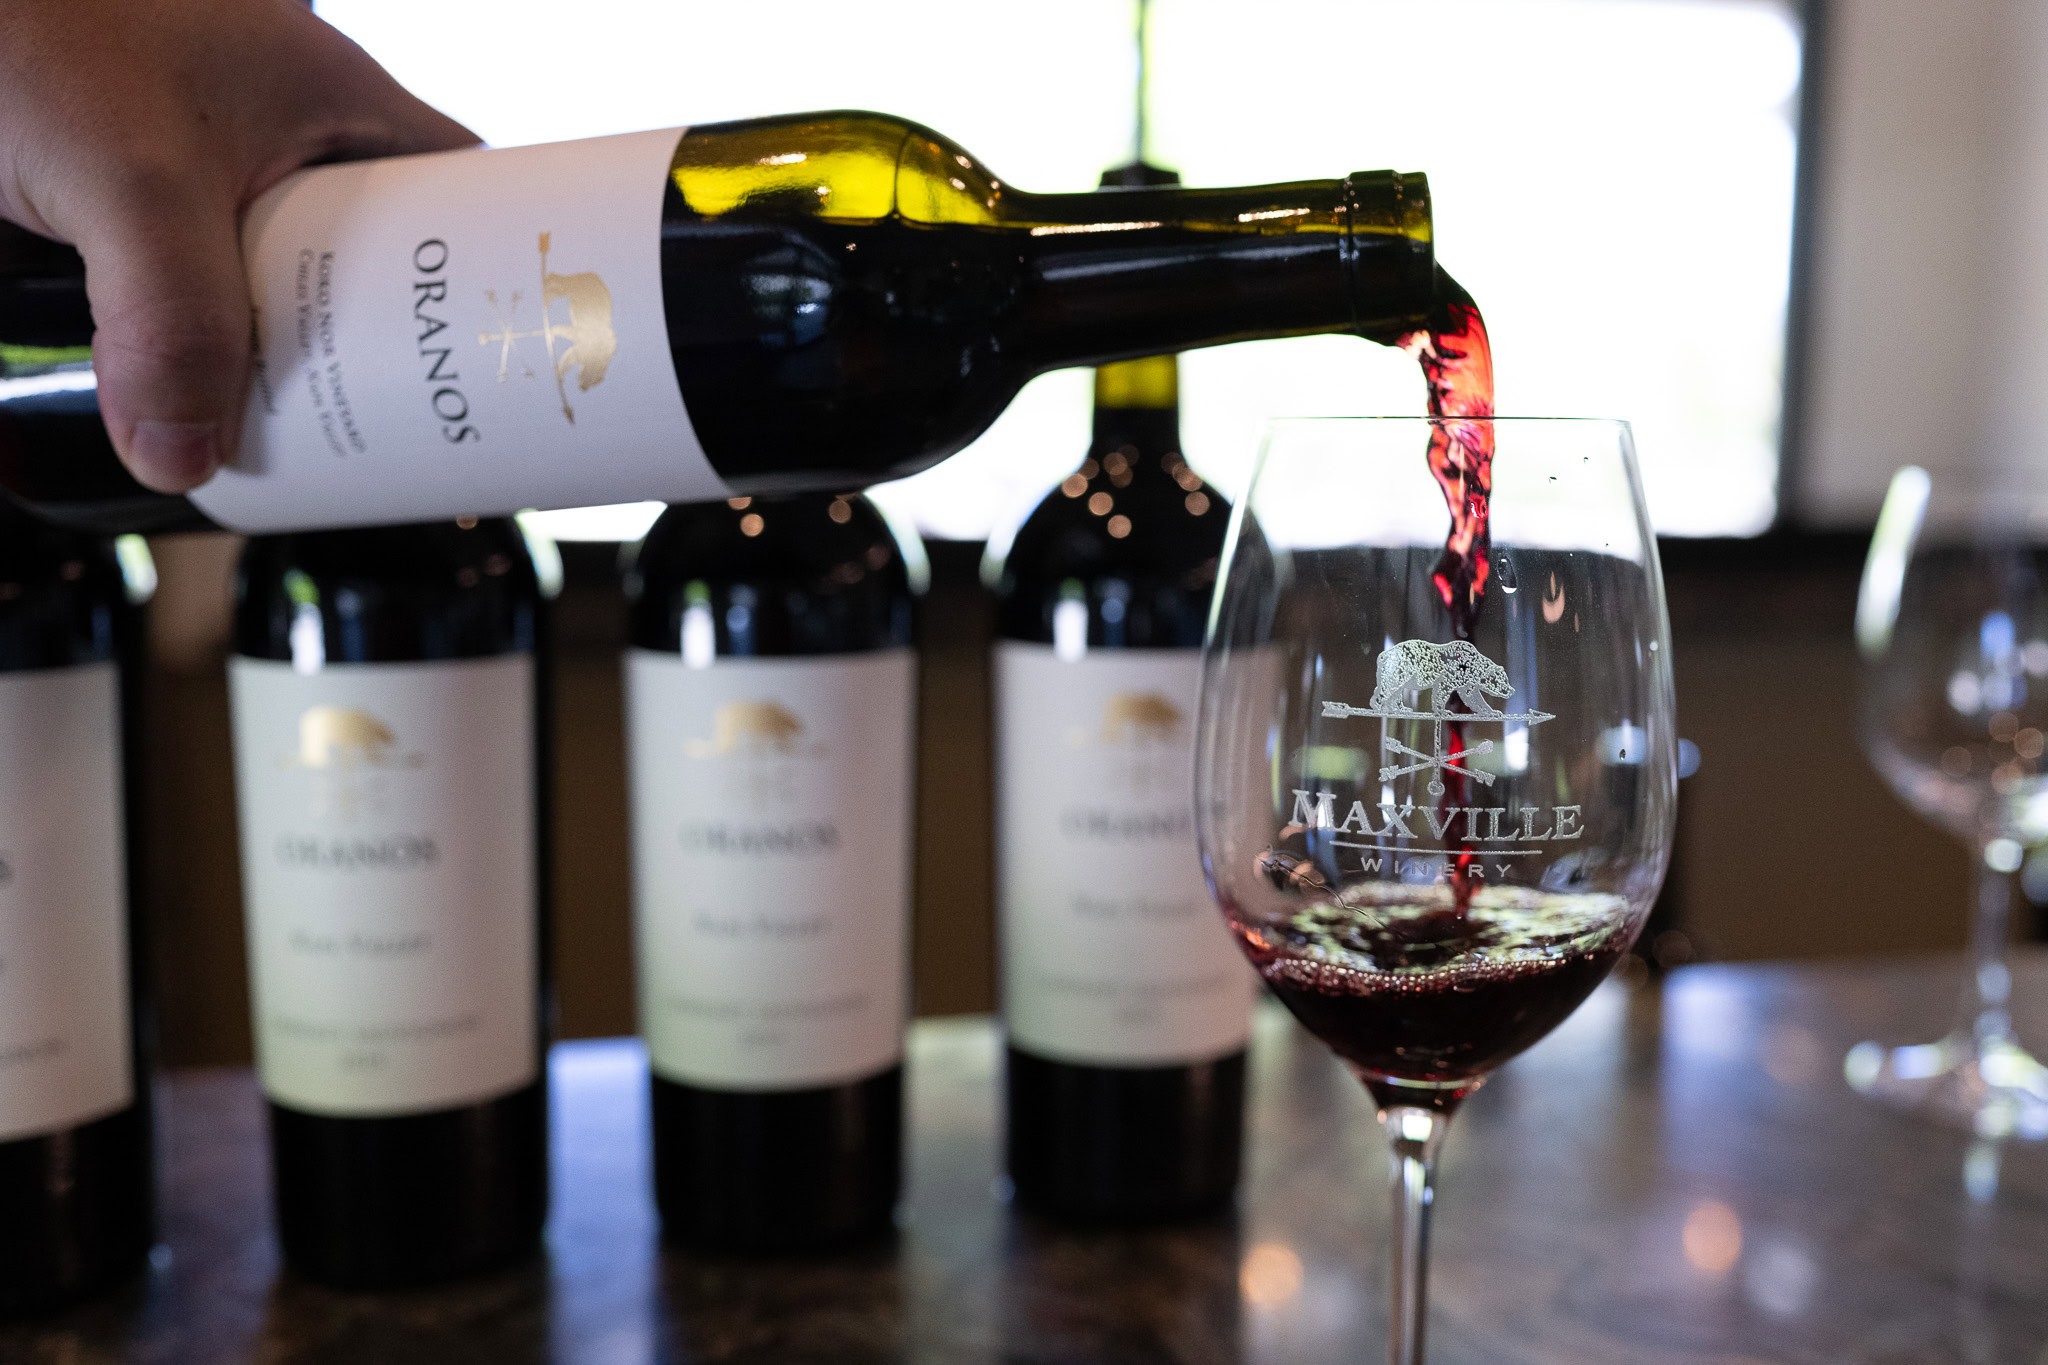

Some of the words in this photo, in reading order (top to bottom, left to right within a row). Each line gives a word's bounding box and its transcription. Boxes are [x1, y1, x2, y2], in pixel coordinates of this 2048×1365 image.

[413, 237, 481, 445] ORANOS
[1288, 789, 1585, 841] MAXVILLE
[1360, 856, 1512, 878] WINERY
